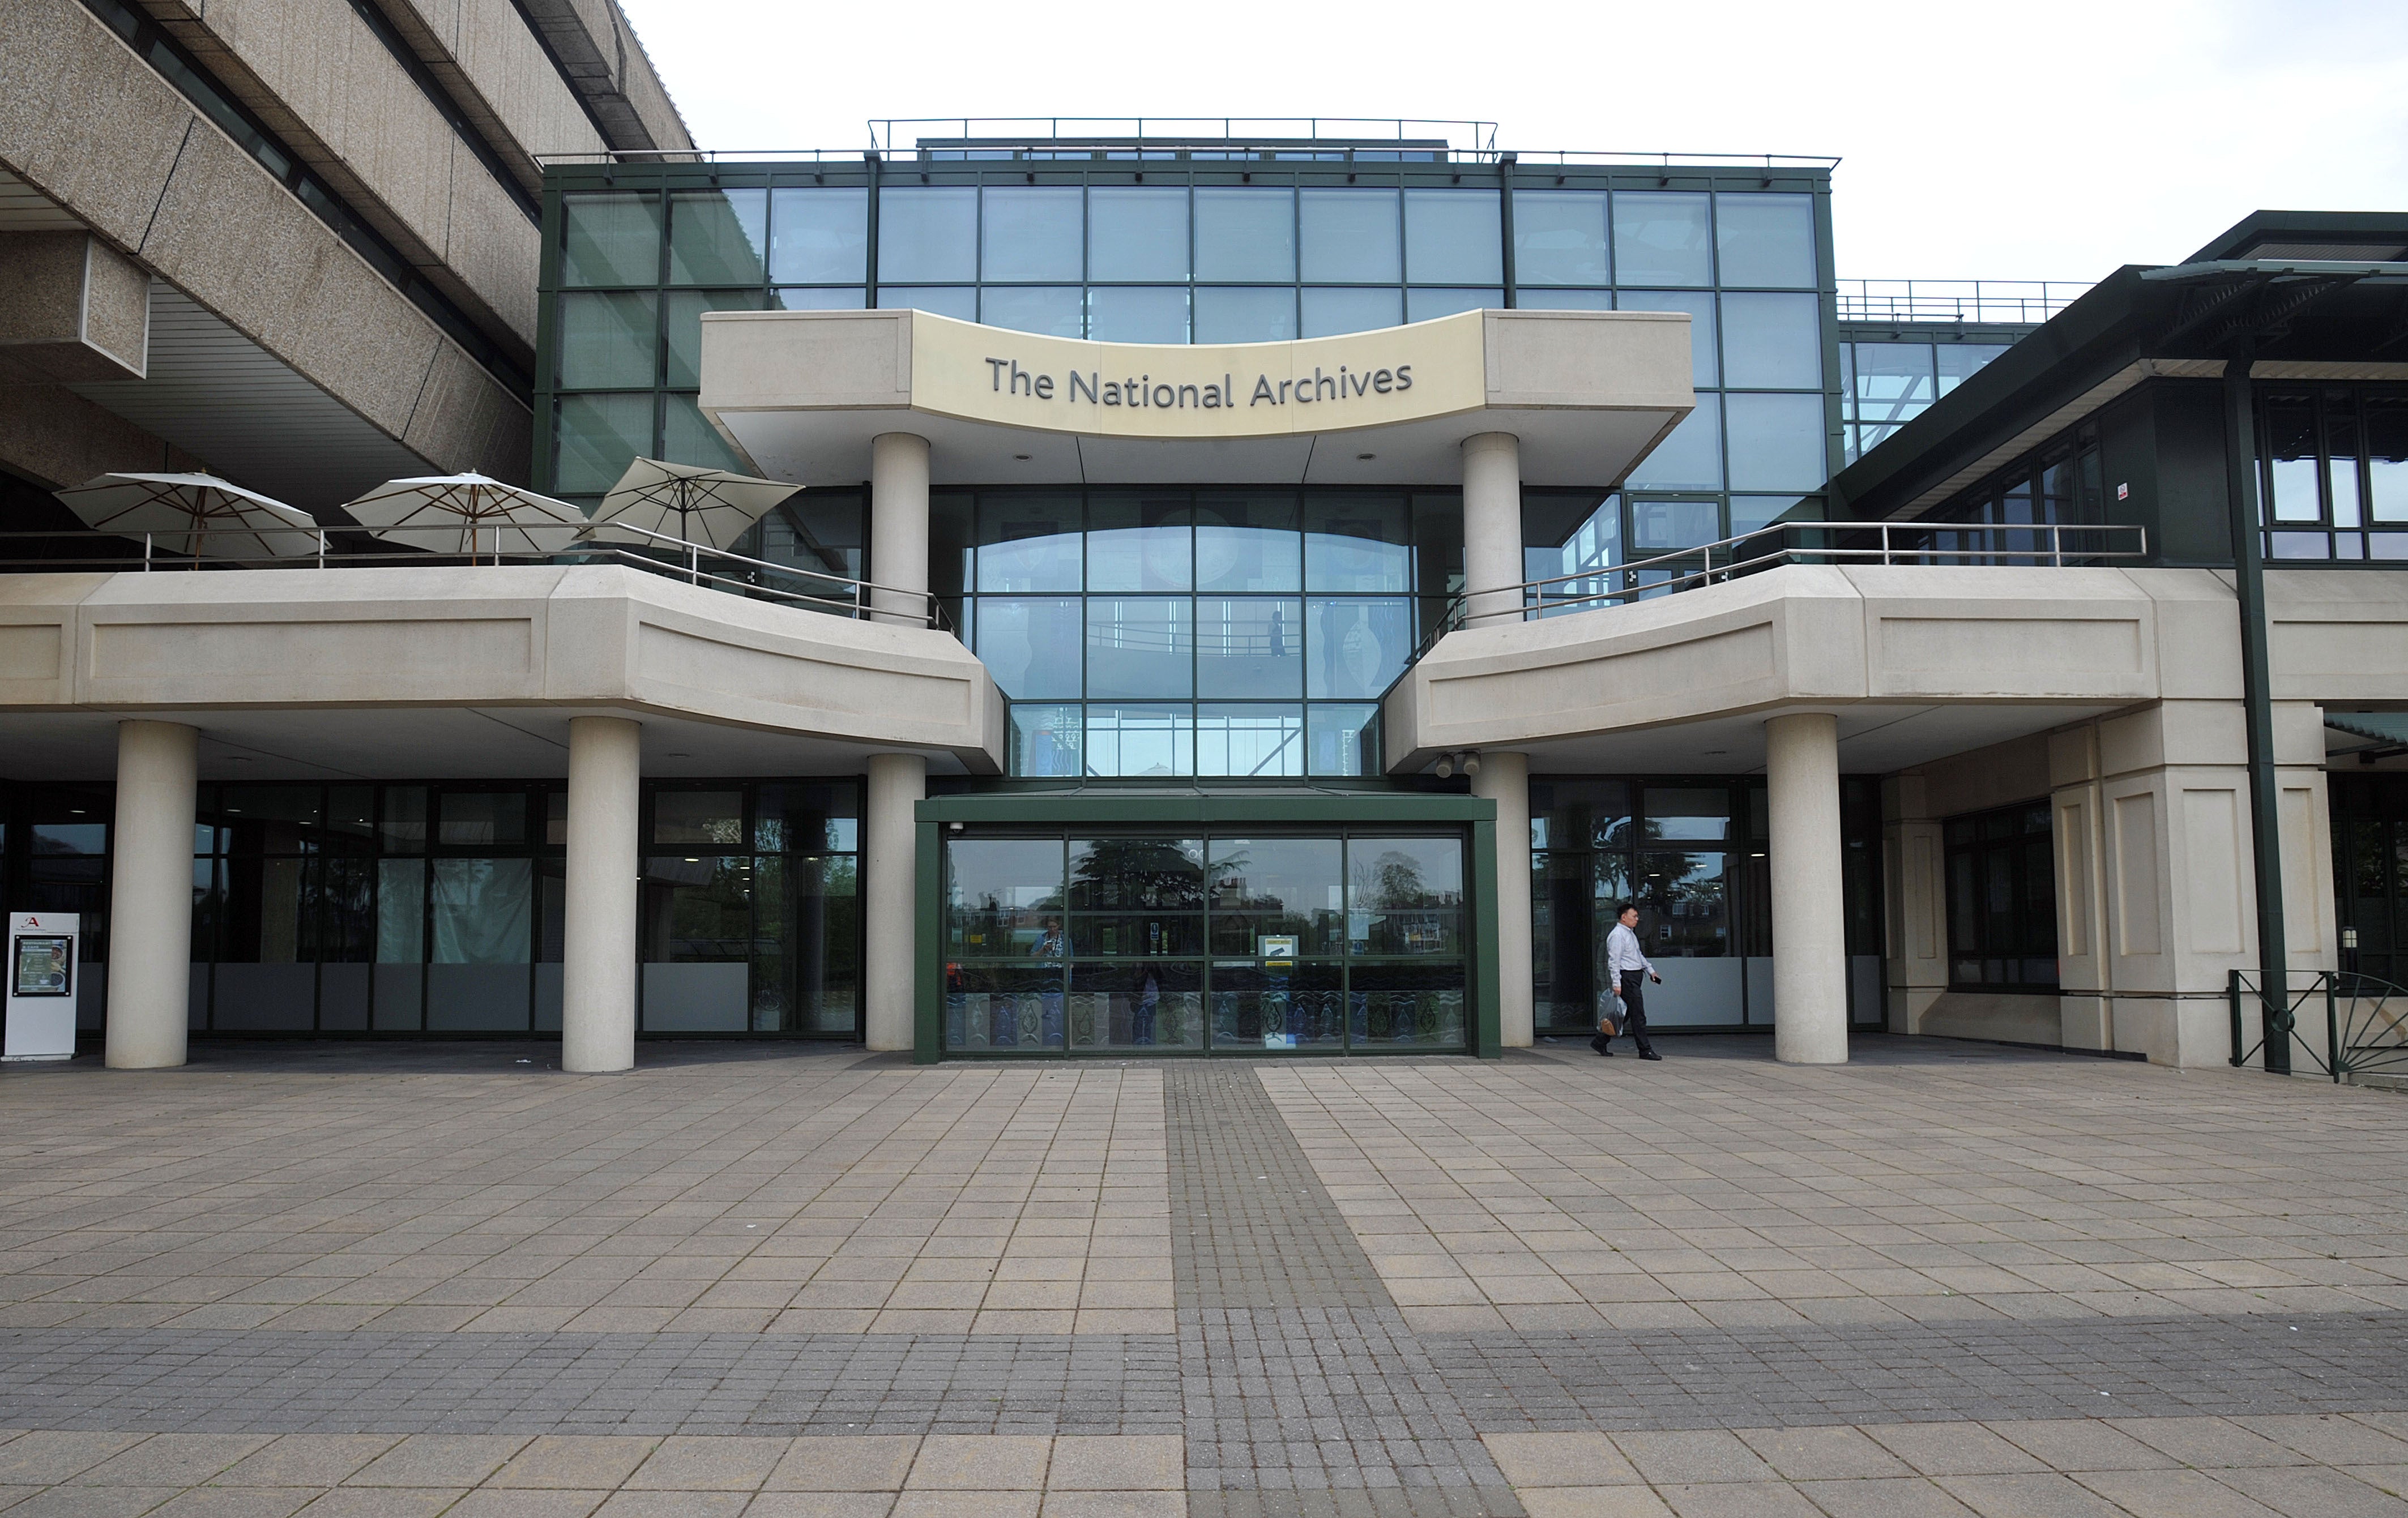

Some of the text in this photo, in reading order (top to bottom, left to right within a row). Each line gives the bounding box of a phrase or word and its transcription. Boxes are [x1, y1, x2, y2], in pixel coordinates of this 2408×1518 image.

[985, 357, 1412, 409] The National Archives
